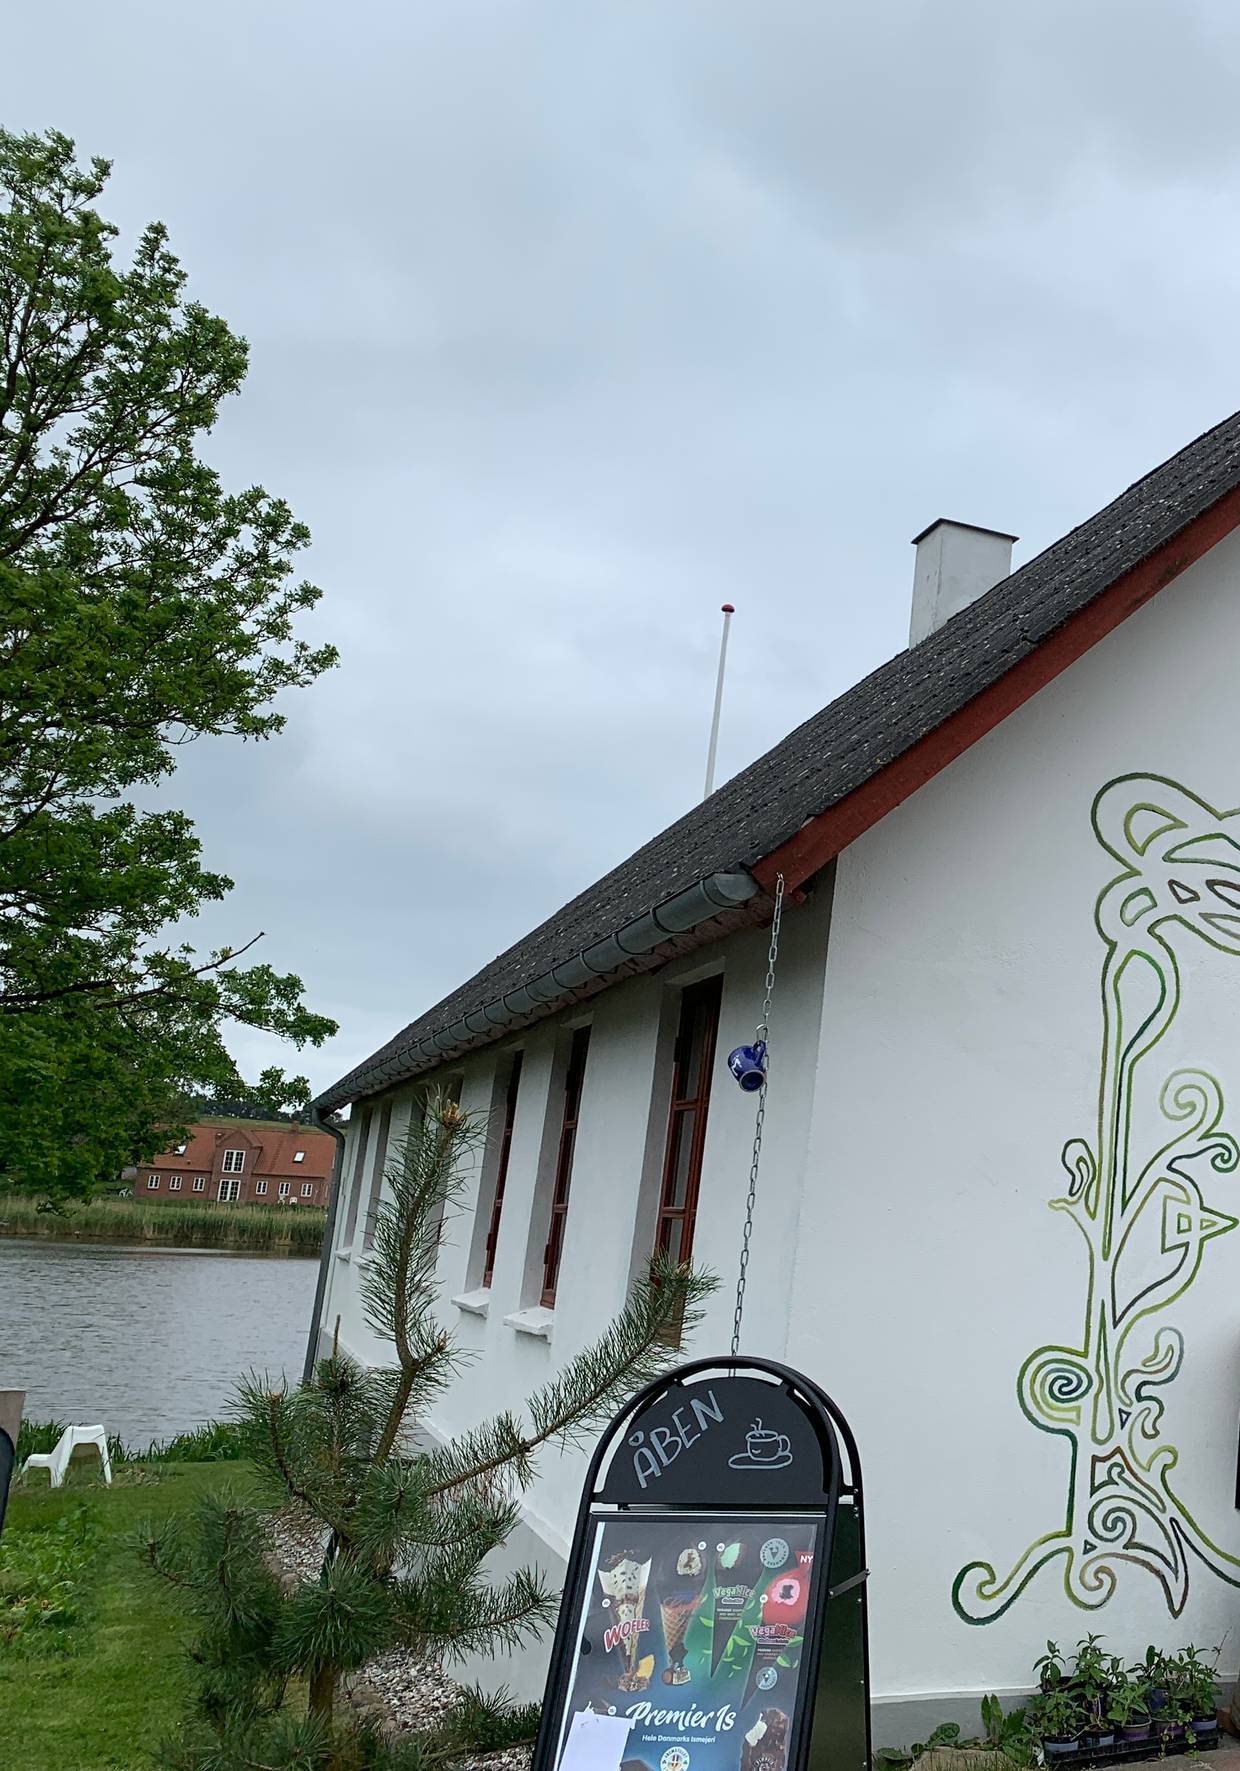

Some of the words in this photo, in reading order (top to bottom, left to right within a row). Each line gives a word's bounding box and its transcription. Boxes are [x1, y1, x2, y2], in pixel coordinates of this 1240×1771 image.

[628, 1389, 725, 1489] ÅBEN
[800, 1554, 814, 1564] NY
[603, 1618, 651, 1653] WOFLER
[625, 1700, 714, 1731] Premier
[715, 1703, 737, 1732] Is
[641, 1734, 657, 1743] Hele
[657, 1734, 690, 1744] Danmarks
[690, 1735, 716, 1745] Ismejeri
